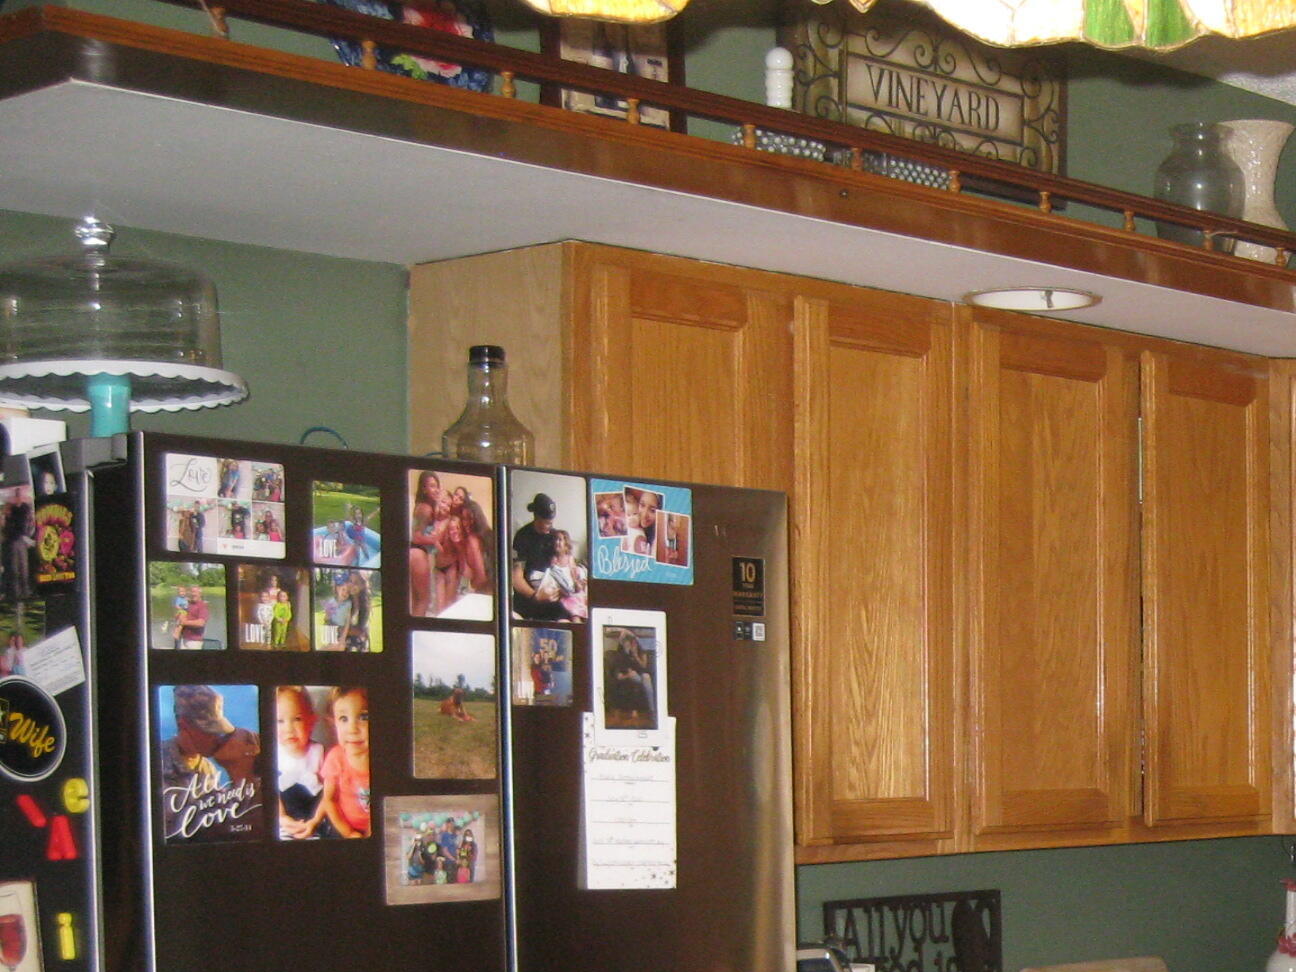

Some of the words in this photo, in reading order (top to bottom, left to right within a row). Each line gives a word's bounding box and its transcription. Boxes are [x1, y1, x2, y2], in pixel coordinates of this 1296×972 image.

[865, 63, 1000, 132] VINEYARD
[169, 457, 213, 492] Love
[320, 538, 339, 558] LOVE
[597, 545, 653, 578] Blessed
[739, 562, 756, 583] 10
[8, 712, 56, 758] Wife
[163, 771, 233, 812] All
[217, 778, 245, 804] need
[164, 802, 262, 838] love
[886, 901, 950, 963] you
